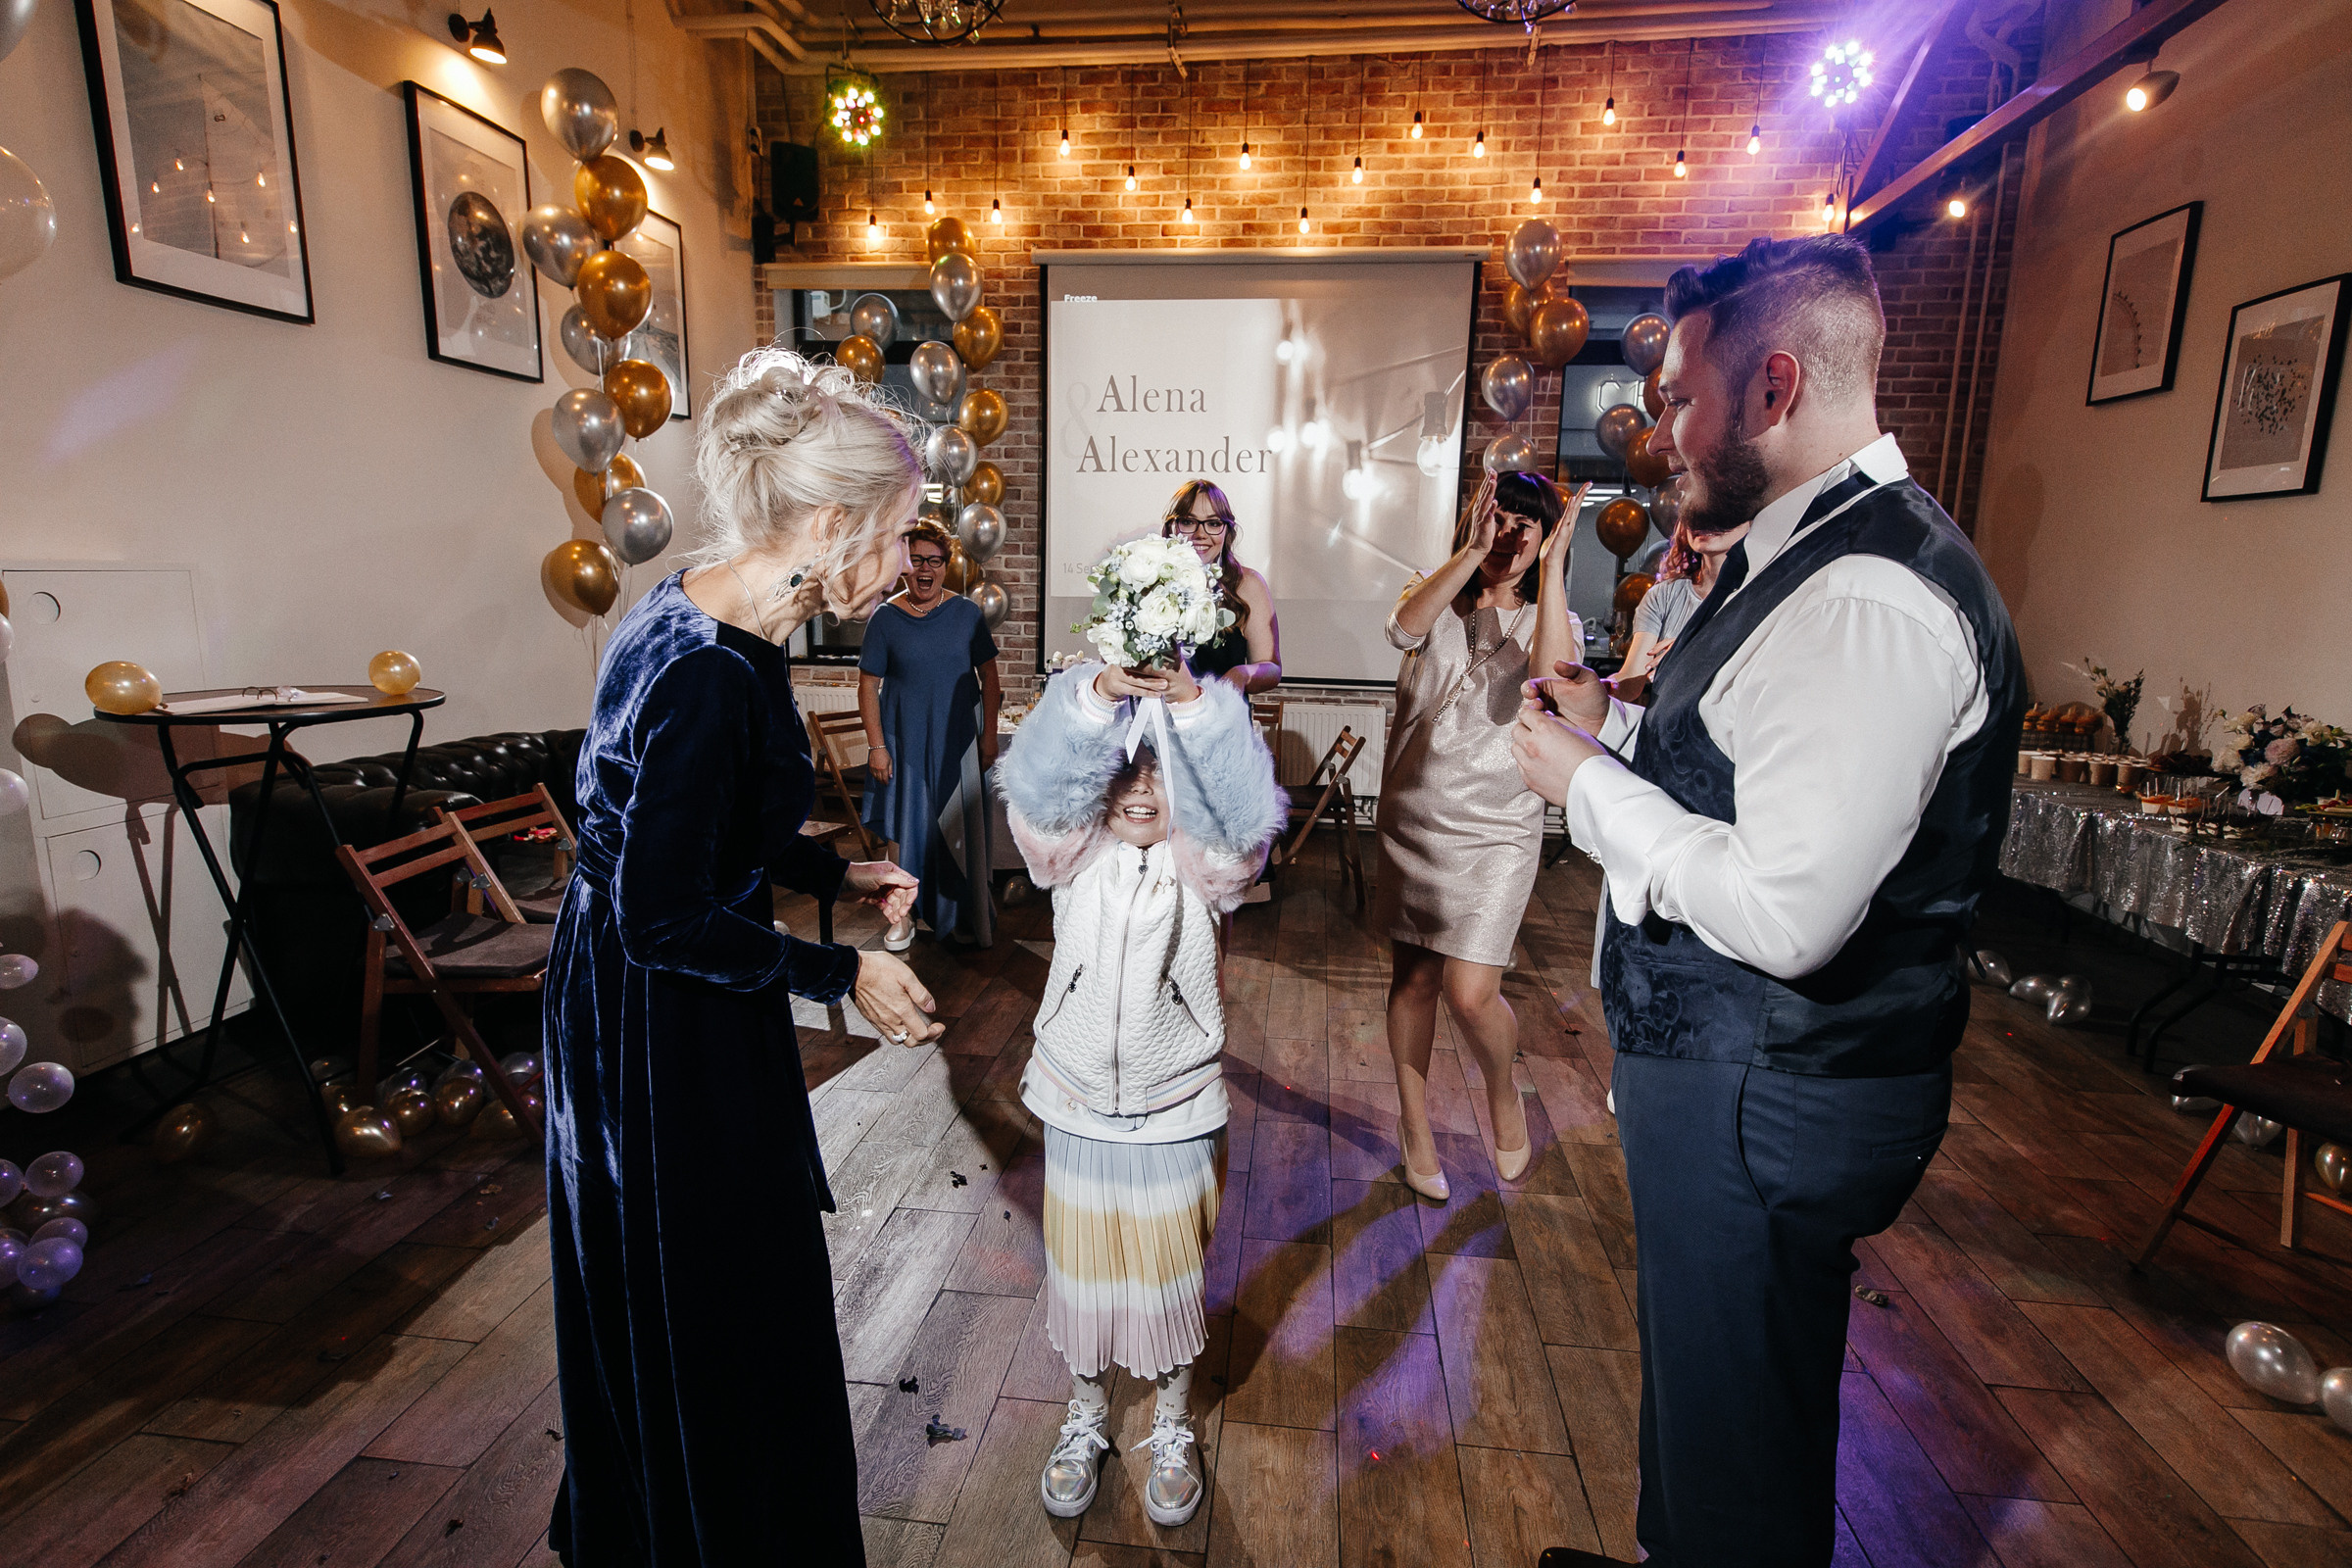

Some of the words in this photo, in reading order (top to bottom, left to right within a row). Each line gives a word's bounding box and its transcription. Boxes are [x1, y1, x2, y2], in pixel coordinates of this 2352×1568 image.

[1063, 293, 1099, 303] Freeze
[1096, 374, 1207, 413] Alena
[1076, 435, 1273, 473] Alexander
